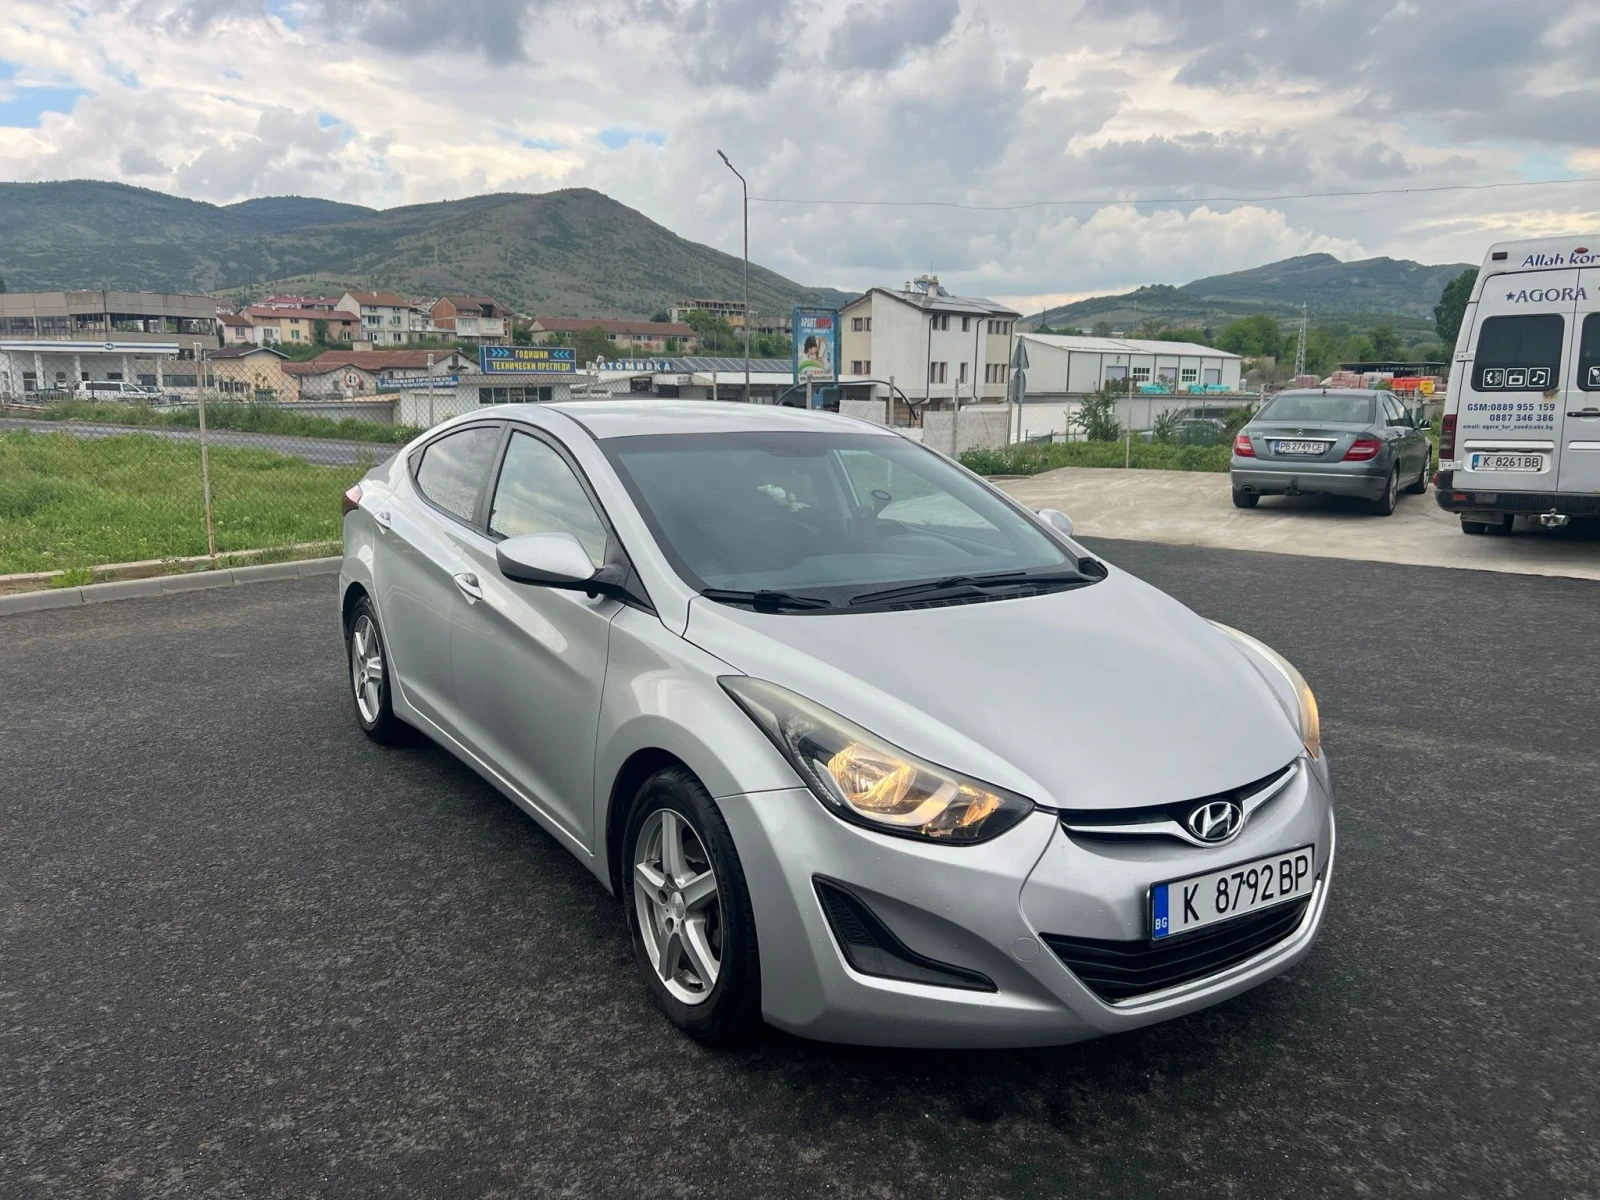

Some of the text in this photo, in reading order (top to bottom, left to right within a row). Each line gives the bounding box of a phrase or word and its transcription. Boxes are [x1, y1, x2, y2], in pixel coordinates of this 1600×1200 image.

[1522, 253, 1564, 267] Allah
[1515, 287, 1588, 303] AGORA
[515, 350, 549, 359] ГОДИШНИ
[492, 361, 571, 371] ТЕХНИЧЕСКИ ПРЕГЛЕДИ
[591, 362, 671, 371] АВТОМИВКА
[1516, 403, 1534, 411] 955
[1538, 403, 1555, 411] 159
[1183, 883, 1200, 924] K
[1155, 917, 1168, 930] BG
